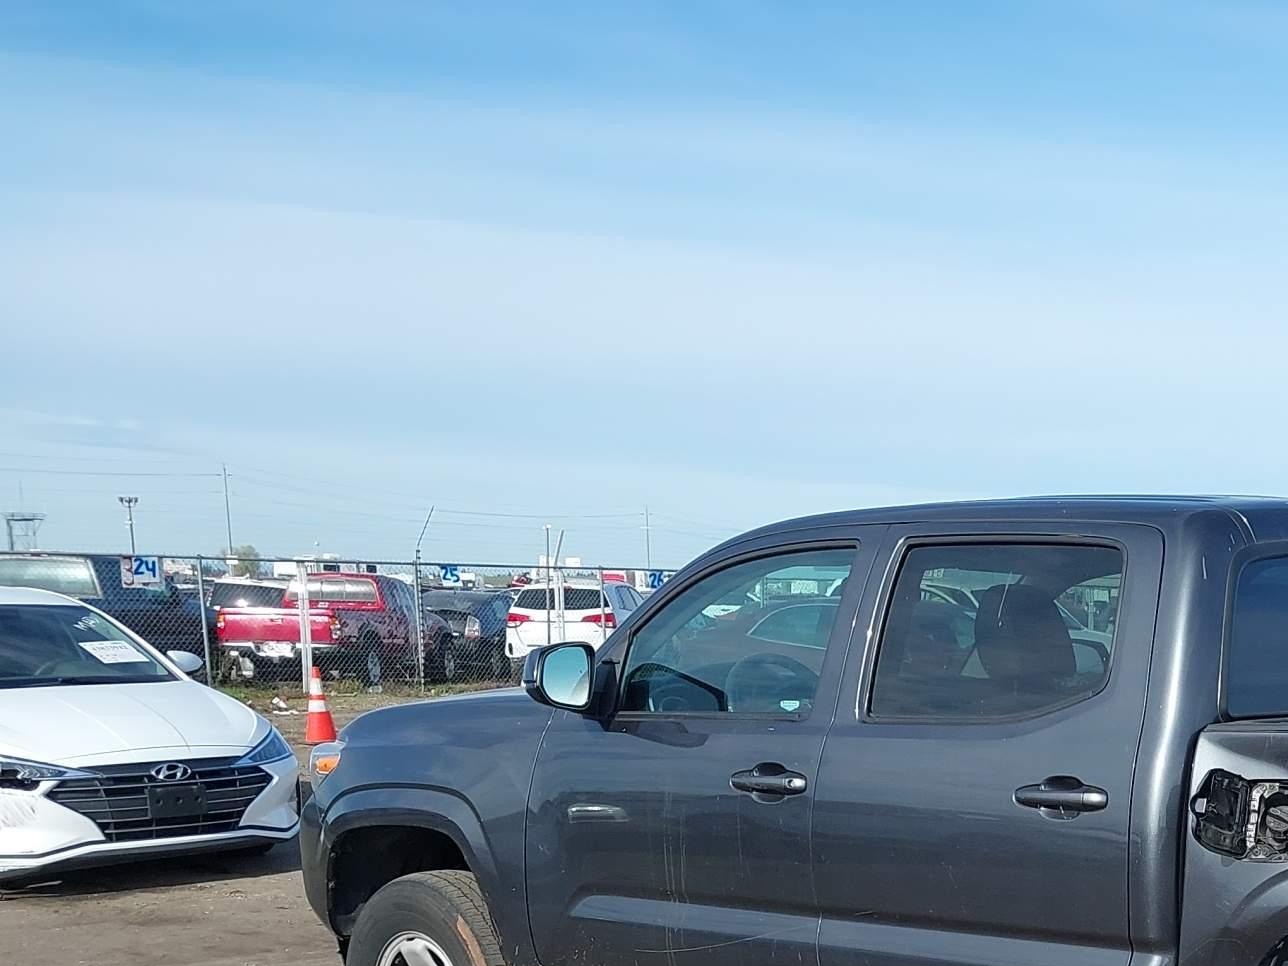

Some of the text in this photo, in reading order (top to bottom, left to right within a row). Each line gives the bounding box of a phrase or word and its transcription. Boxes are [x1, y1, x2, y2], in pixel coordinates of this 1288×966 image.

[133, 558, 156, 578] 24
[441, 566, 460, 583] 25
[649, 571, 664, 588] 26
